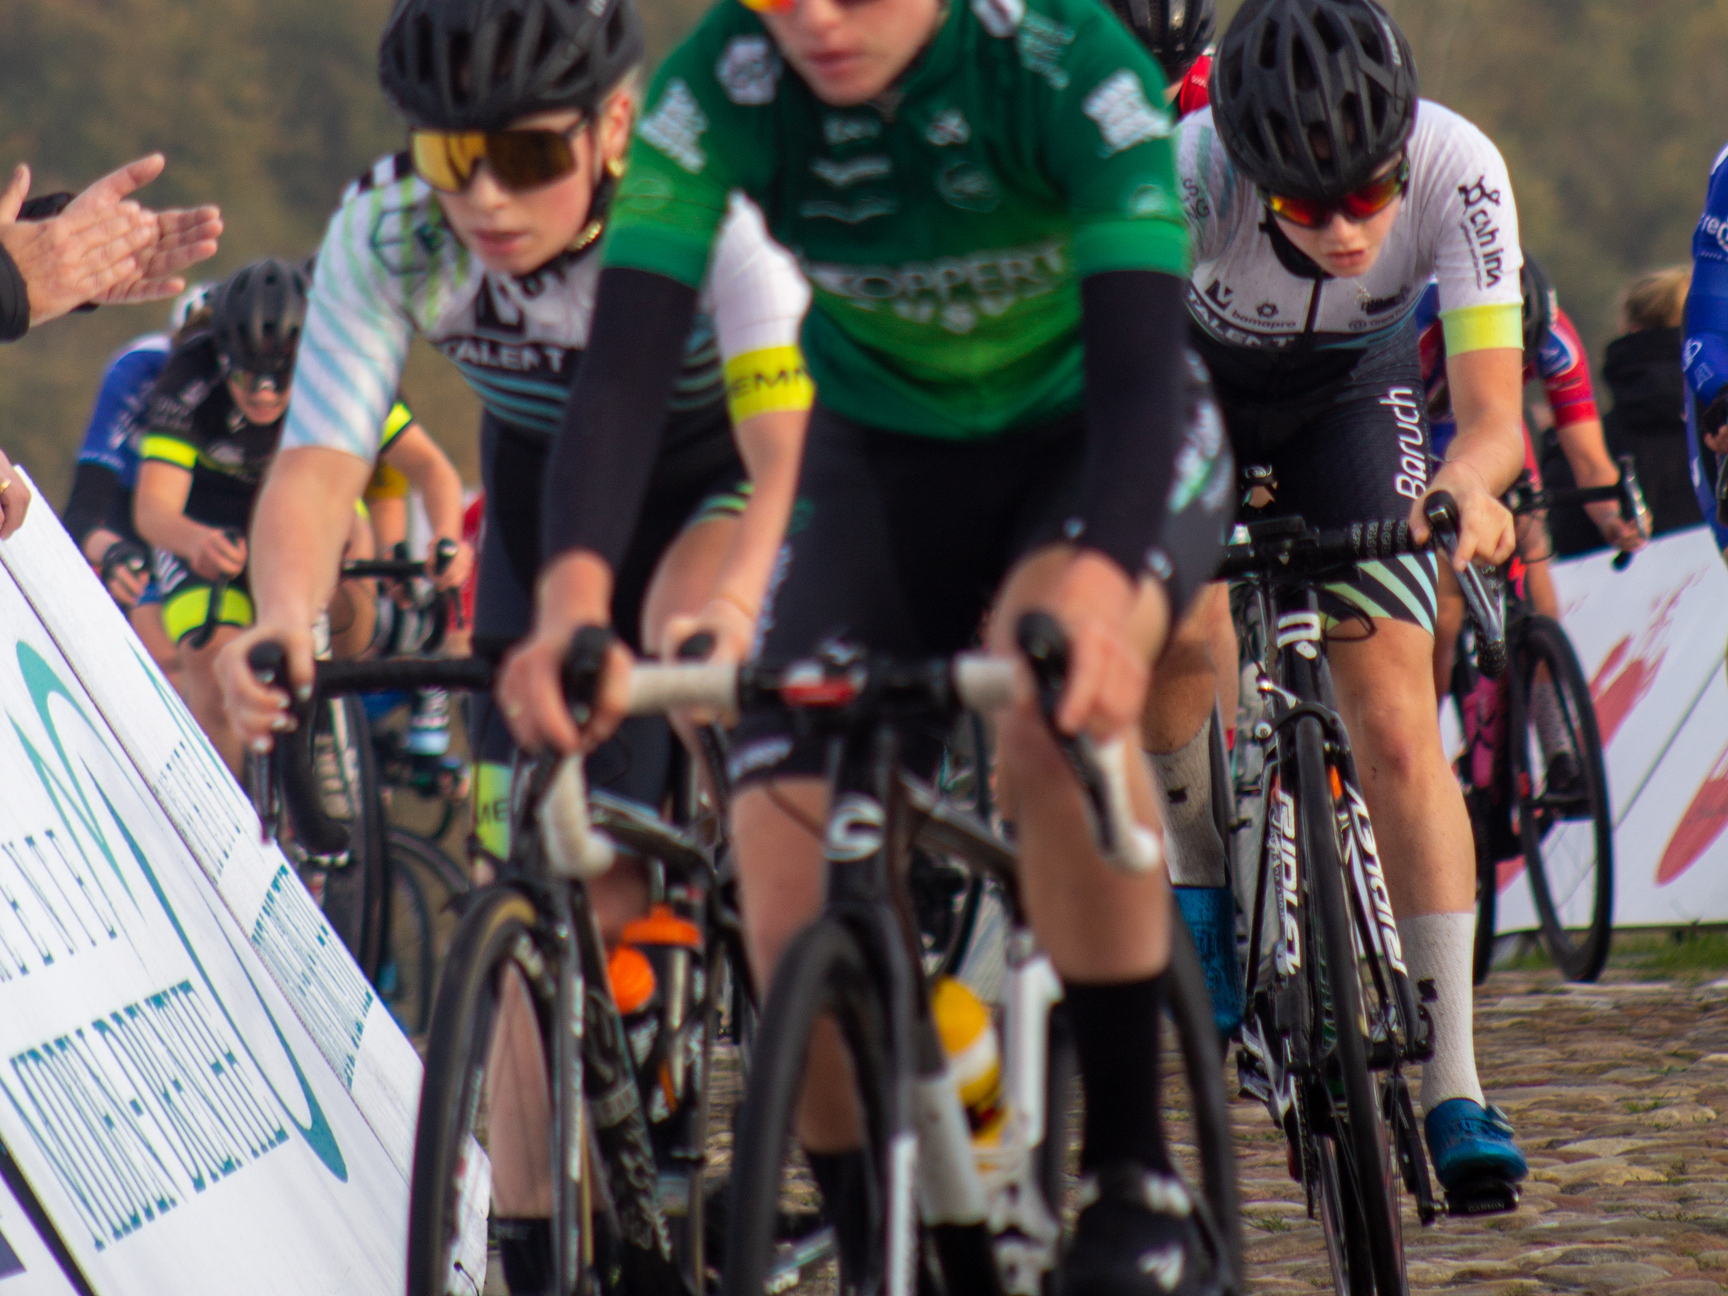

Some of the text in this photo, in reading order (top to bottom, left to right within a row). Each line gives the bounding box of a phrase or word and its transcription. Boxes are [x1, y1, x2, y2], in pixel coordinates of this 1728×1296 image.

[1378, 387, 1427, 500] Baruch
[1279, 788, 1301, 976] RIDLEY
[1344, 779, 1409, 978] RIDLEY
[1467, 1202, 1505, 1213] GARMIN
